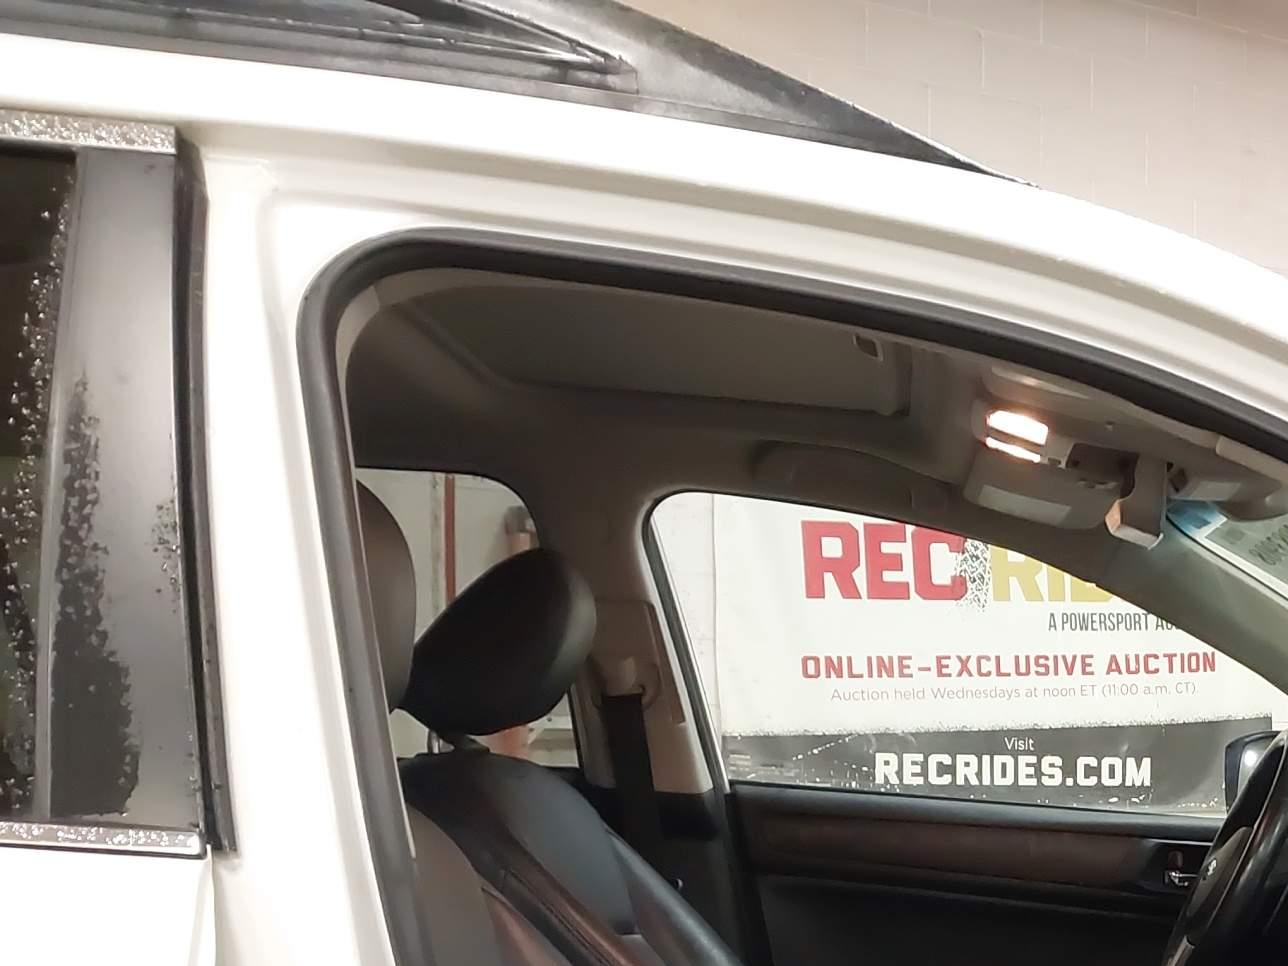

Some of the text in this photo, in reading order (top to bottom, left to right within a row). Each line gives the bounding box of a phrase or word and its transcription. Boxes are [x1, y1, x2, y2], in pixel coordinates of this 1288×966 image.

[1049, 612, 1057, 631] A
[1062, 612, 1149, 631] POWERSPORT
[801, 652, 1216, 679] ONLINE-EXCLUSIVE AUCTION
[831, 687, 889, 701] Auction
[895, 686, 925, 700] held
[931, 685, 1020, 702] Wednesdays
[1025, 686, 1038, 699] at
[1043, 687, 1075, 698] noon
[1080, 684, 1097, 697] ET
[1004, 737, 1034, 750] Visit
[875, 753, 1151, 787] RECRIDES.COM
